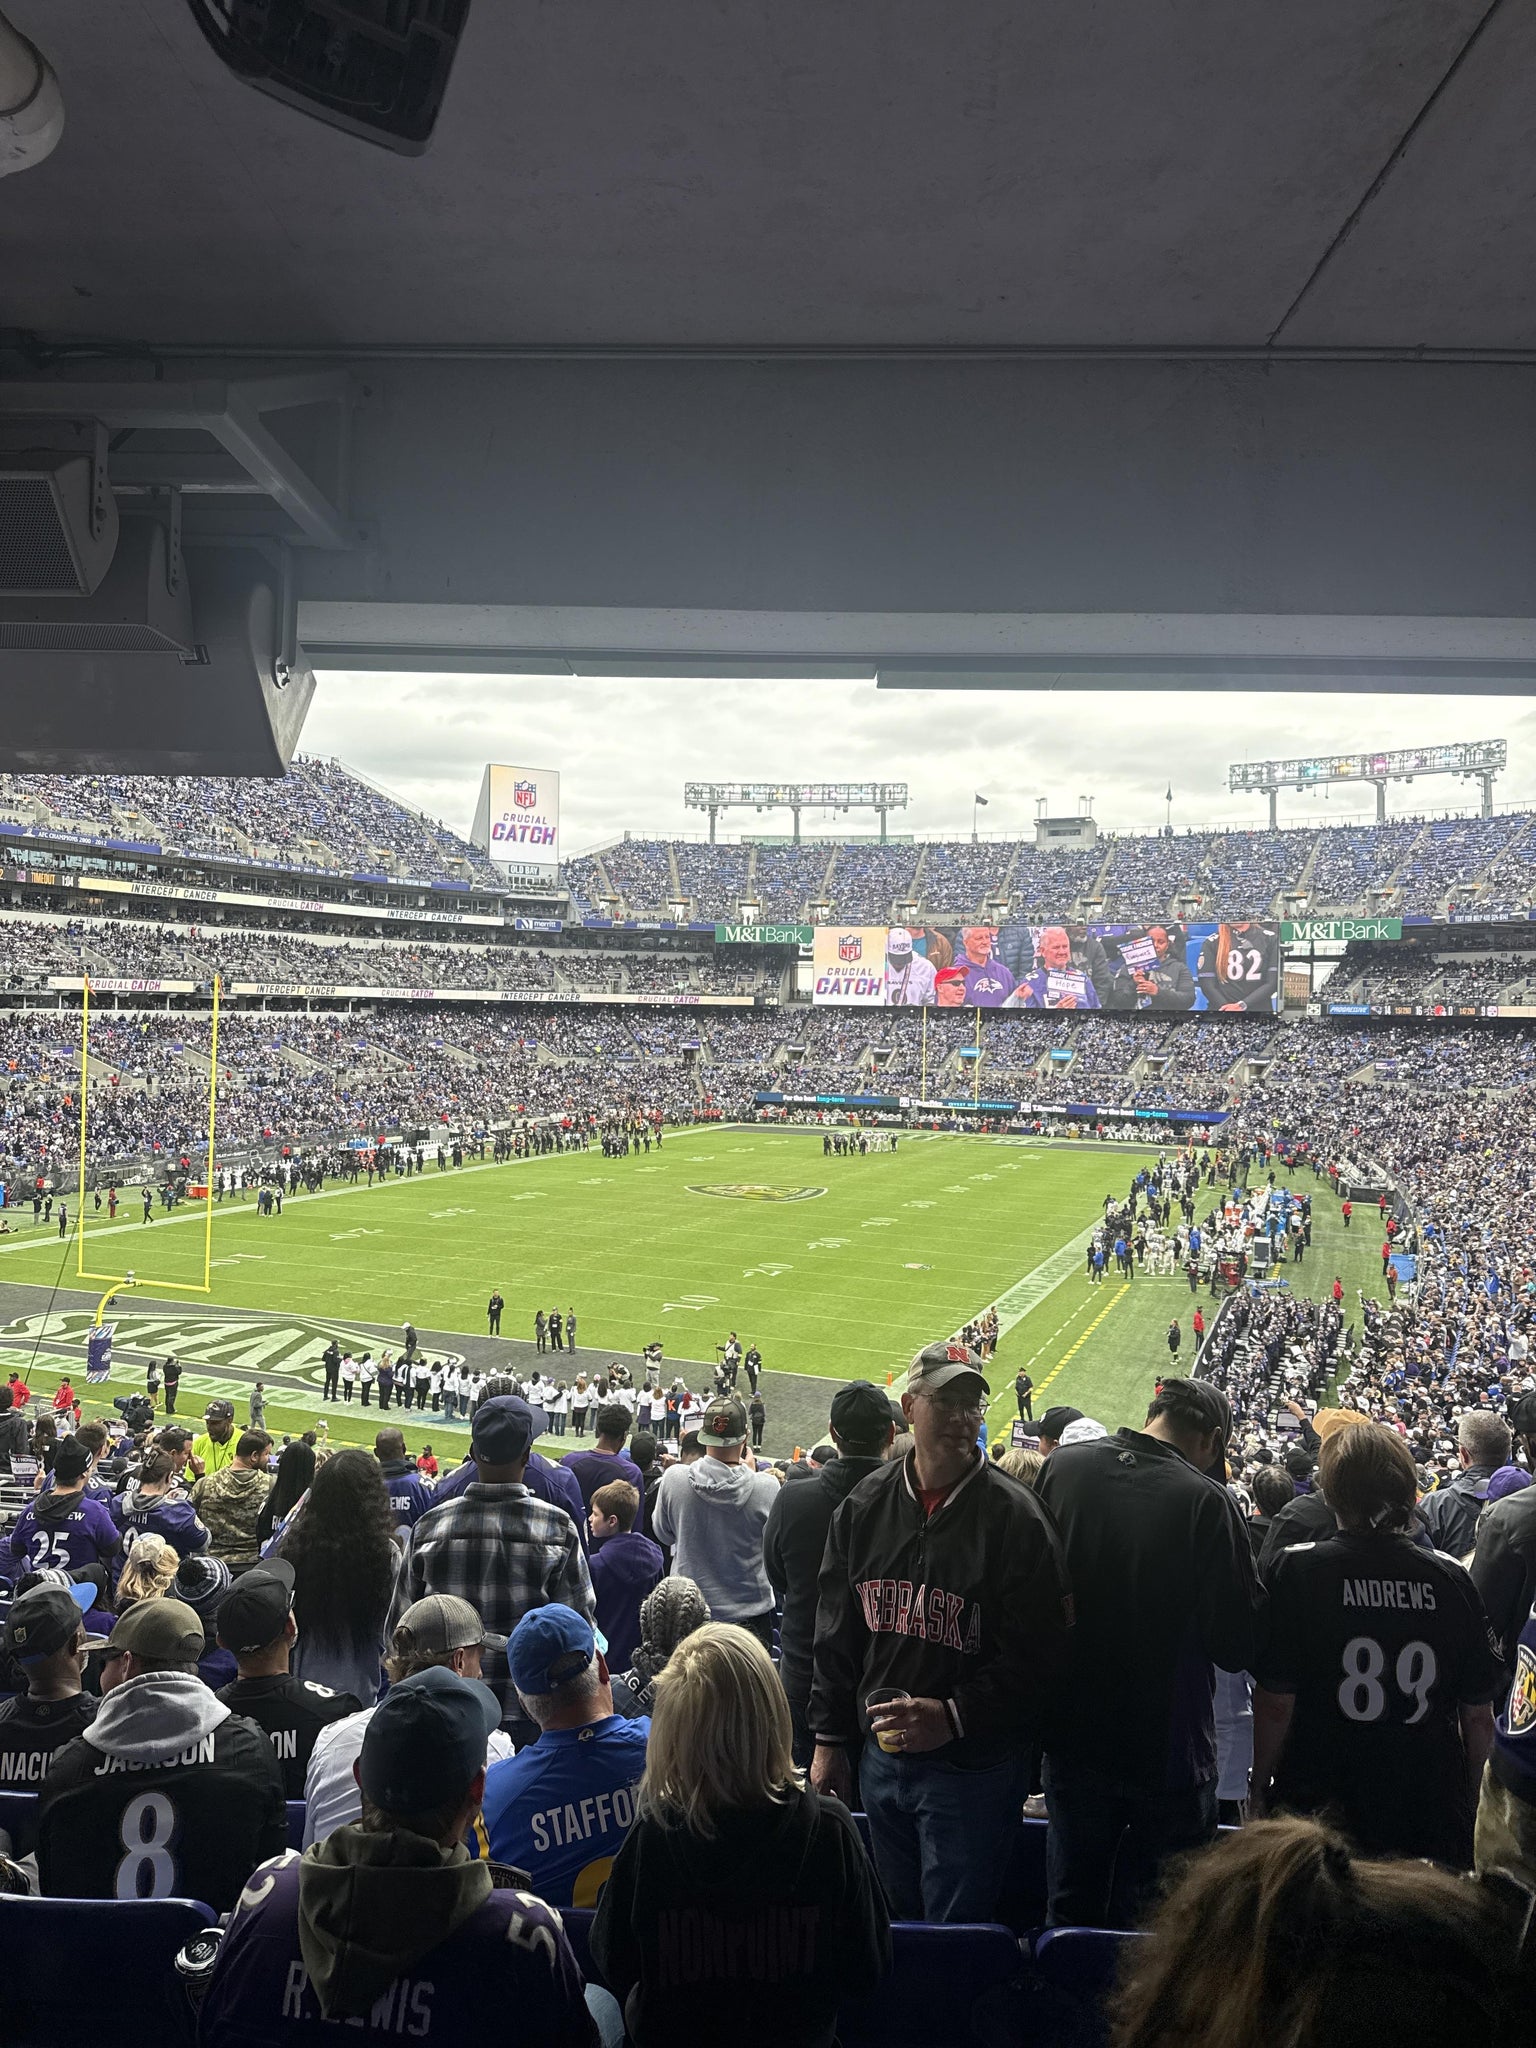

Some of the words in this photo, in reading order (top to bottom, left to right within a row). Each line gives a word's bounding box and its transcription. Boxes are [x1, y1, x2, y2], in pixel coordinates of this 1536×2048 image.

[515, 791, 535, 806] NFL
[503, 813, 547, 825] CRUCIAL
[49, 832, 78, 843] CHAMPIONS
[492, 822, 557, 846] CATCH
[510, 865, 524, 874] OLD
[525, 867, 539, 875] BAY
[31, 871, 56, 885] TIMEOUT
[131, 884, 180, 897] INTERCEPT
[183, 890, 217, 901] CANCER
[267, 898, 299, 908] CRUCIAL
[300, 902, 324, 912] CATCH
[387, 910, 428, 920] INTERCEPT
[431, 913, 463, 922] CANCER
[725, 926, 764, 943] M&T
[765, 926, 803, 943] Bank
[1292, 921, 1341, 940] M&T
[1342, 920, 1389, 940] Bank
[841, 945, 861, 958] NFL
[827, 967, 873, 976] CRUCIAL
[1227, 949, 1262, 980] 82
[88, 980, 129, 989] CRUCIAL
[131, 980, 161, 991] CATCH
[256, 984, 301, 994] INTERCEPT
[304, 986, 336, 995] CANCER
[816, 977, 883, 996] CATCH
[381, 989, 410, 998] CRUCIAL
[411, 990, 434, 998] CATCH
[500, 993, 544, 1001] INTERCEPT
[548, 993, 581, 1001] CANCER
[638, 995, 674, 1003] CRUCIAL
[673, 996, 700, 1004] CATCH
[662, 1294, 720, 1312] 10
[390, 1496, 411, 1511] EWIS
[31, 1530, 71, 1570] 25
[1343, 1577, 1437, 1612] ANDREWS
[1337, 1637, 1439, 1725] 89
[116, 1792, 176, 1899] 8
